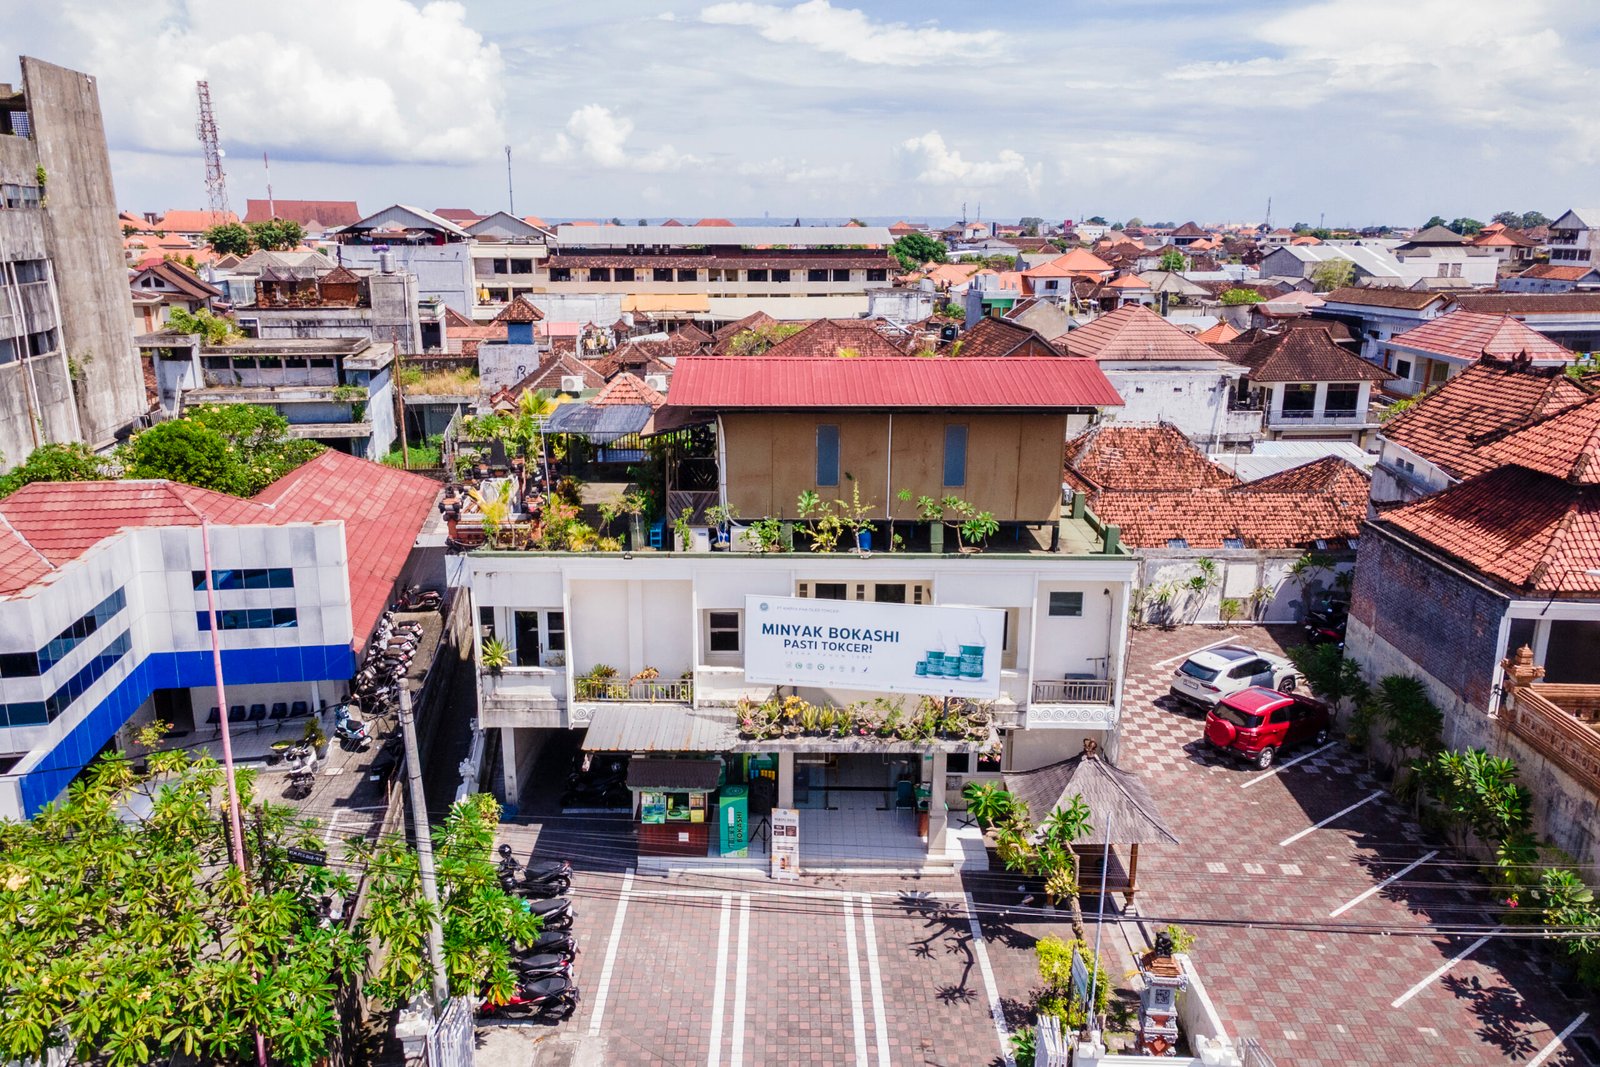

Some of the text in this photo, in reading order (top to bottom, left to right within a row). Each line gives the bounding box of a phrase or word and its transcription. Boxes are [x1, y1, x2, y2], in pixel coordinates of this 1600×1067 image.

[762, 623, 899, 643] MINYAK BOKASHI
[784, 639, 873, 654] PASTI TOKCER!
